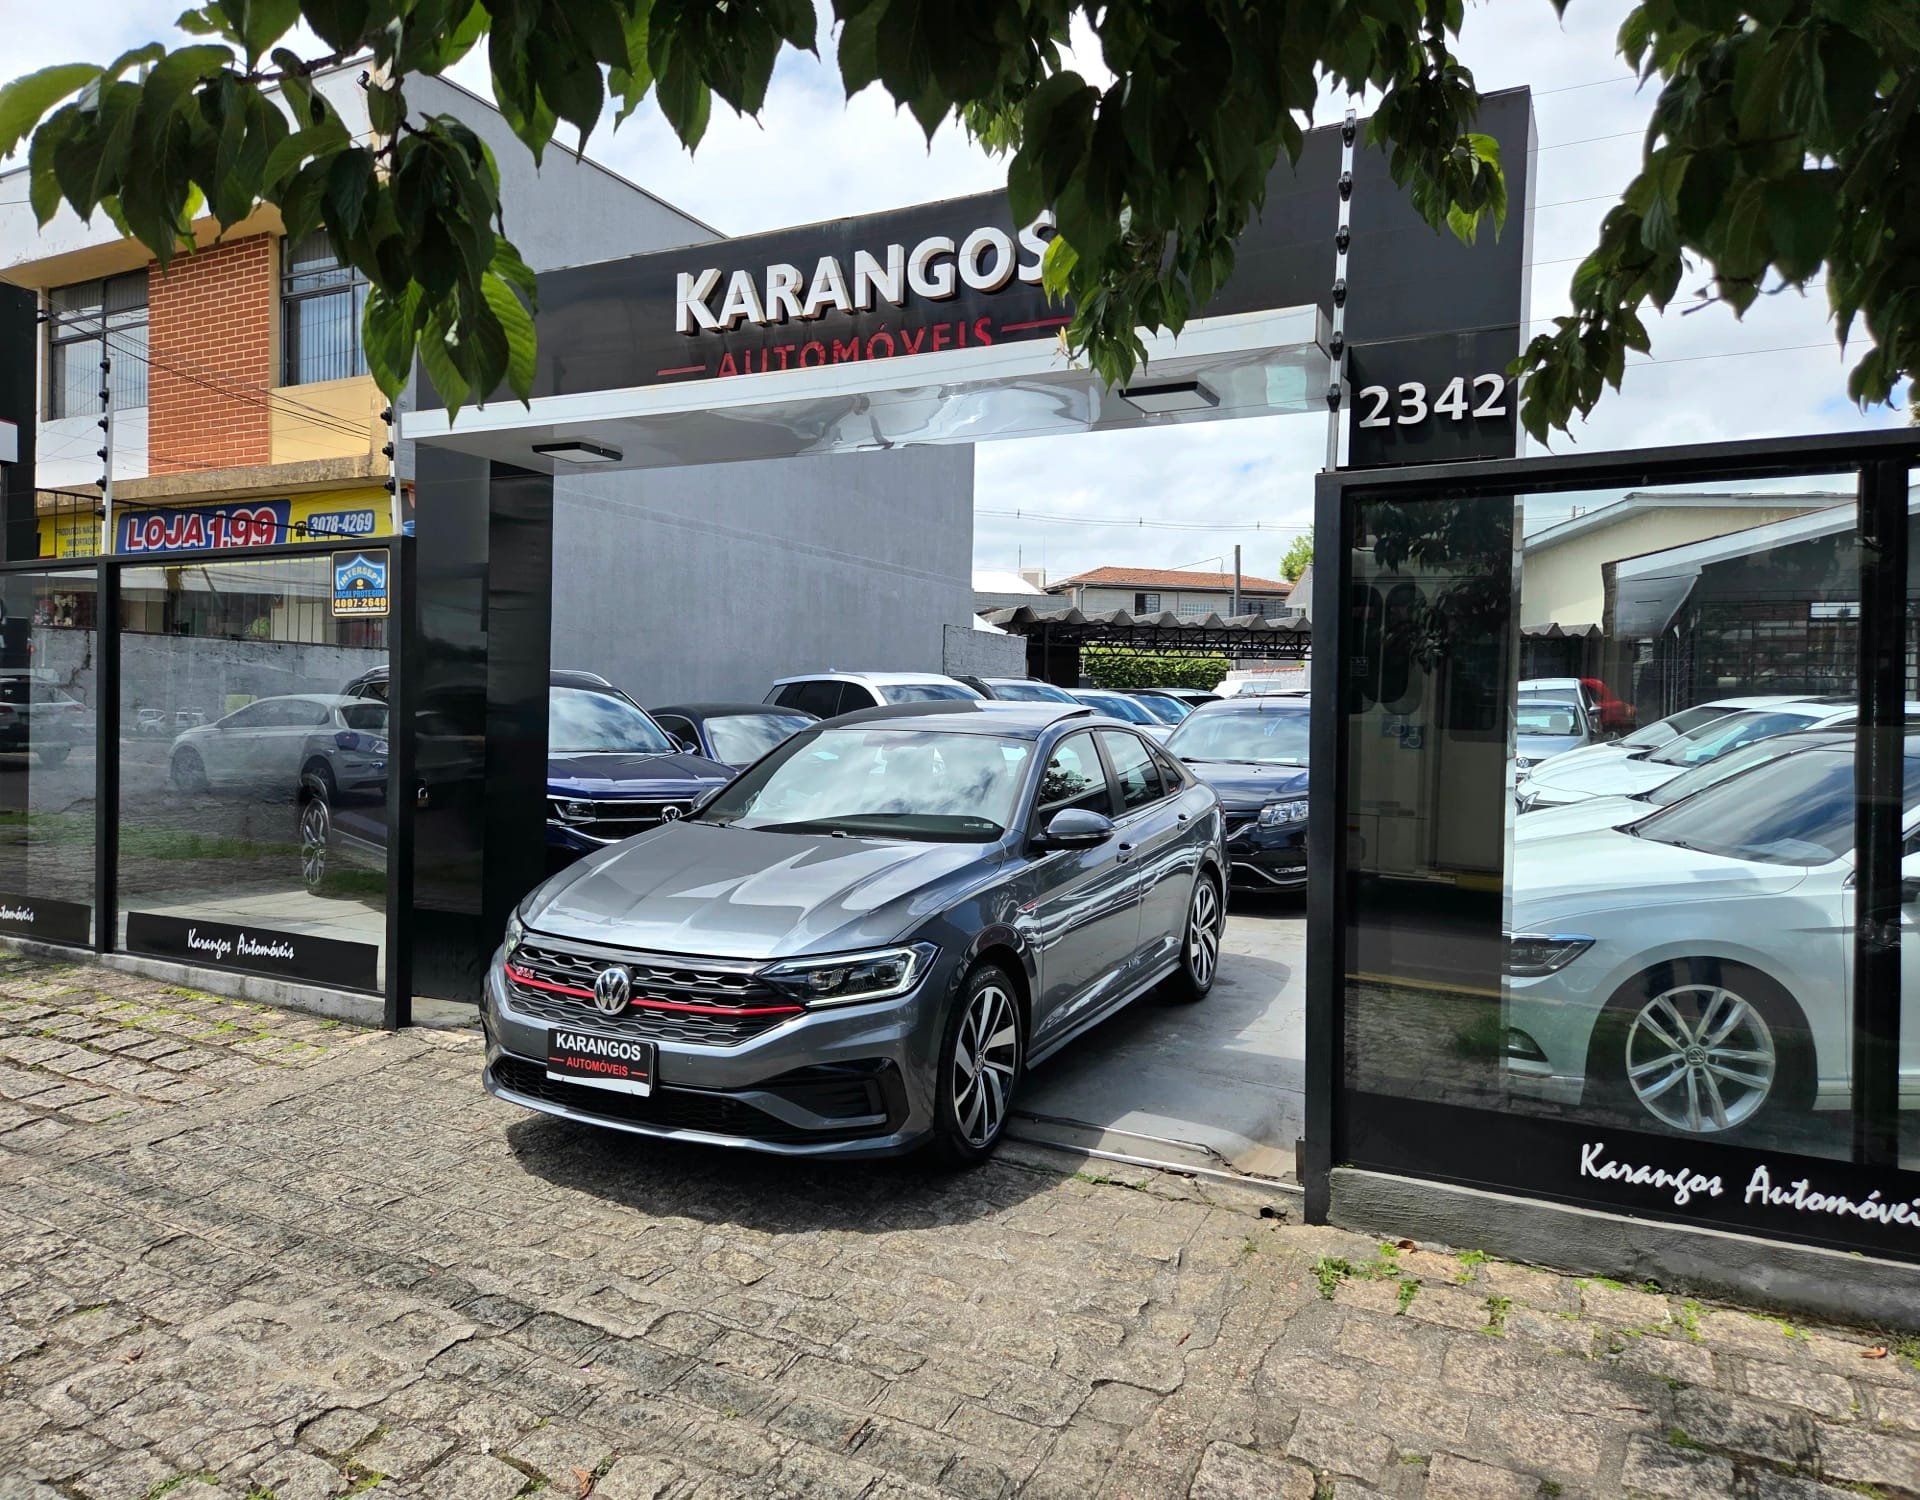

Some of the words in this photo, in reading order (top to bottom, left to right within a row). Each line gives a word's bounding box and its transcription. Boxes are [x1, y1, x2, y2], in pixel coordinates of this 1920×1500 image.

[676, 209, 1056, 334] KARANGOS
[1359, 373, 1506, 428] 2342
[126, 513, 206, 550] LOJA
[311, 513, 373, 535] 3078-4269
[0, 904, 35, 923] tomóveis
[187, 927, 231, 960] Karangos
[236, 932, 294, 960] Automóveis
[556, 1032, 641, 1061] KARANGOS
[566, 1056, 629, 1077] AUTOMÓVEIS
[1580, 1142, 1723, 1205] Karangos
[1744, 1164, 1920, 1227] Automóvei
